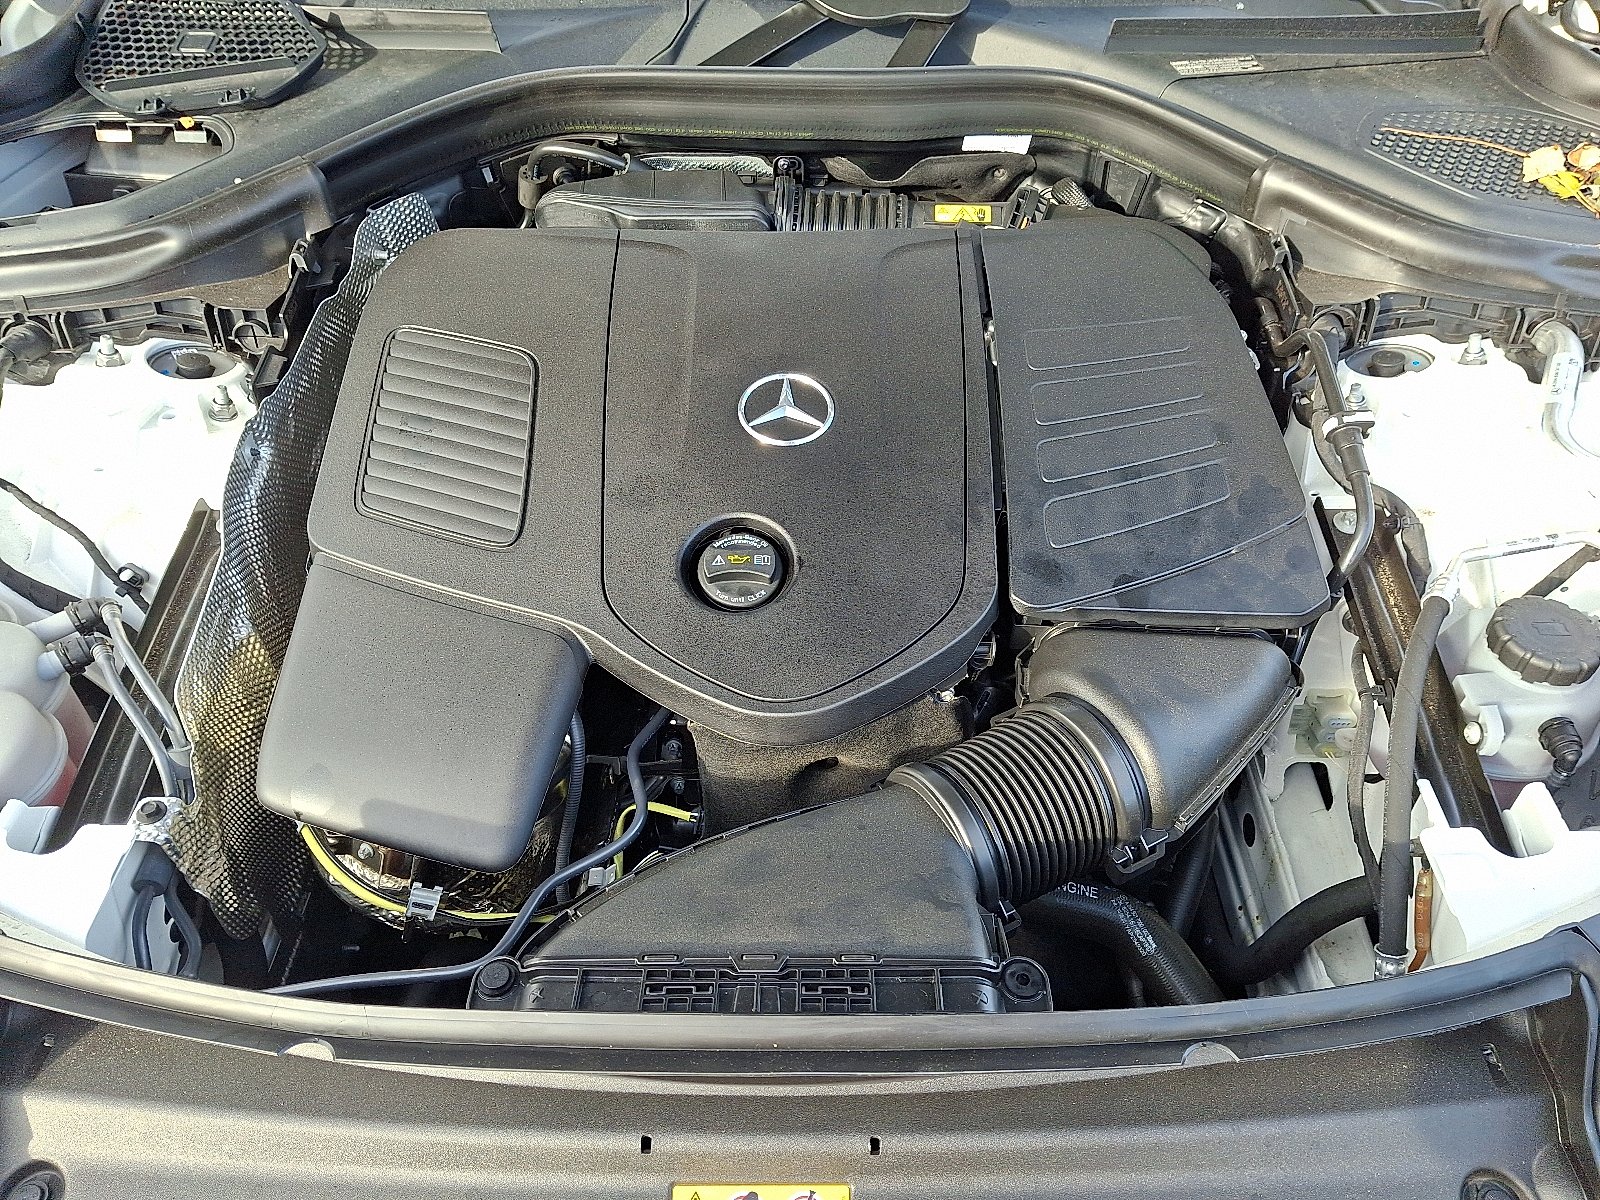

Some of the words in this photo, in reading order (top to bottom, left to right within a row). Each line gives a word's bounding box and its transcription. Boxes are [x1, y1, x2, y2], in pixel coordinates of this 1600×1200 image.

[712, 534, 760, 548] Mercedes-Benz
[720, 539, 761, 549] recommended
[747, 589, 767, 602] CLICK
